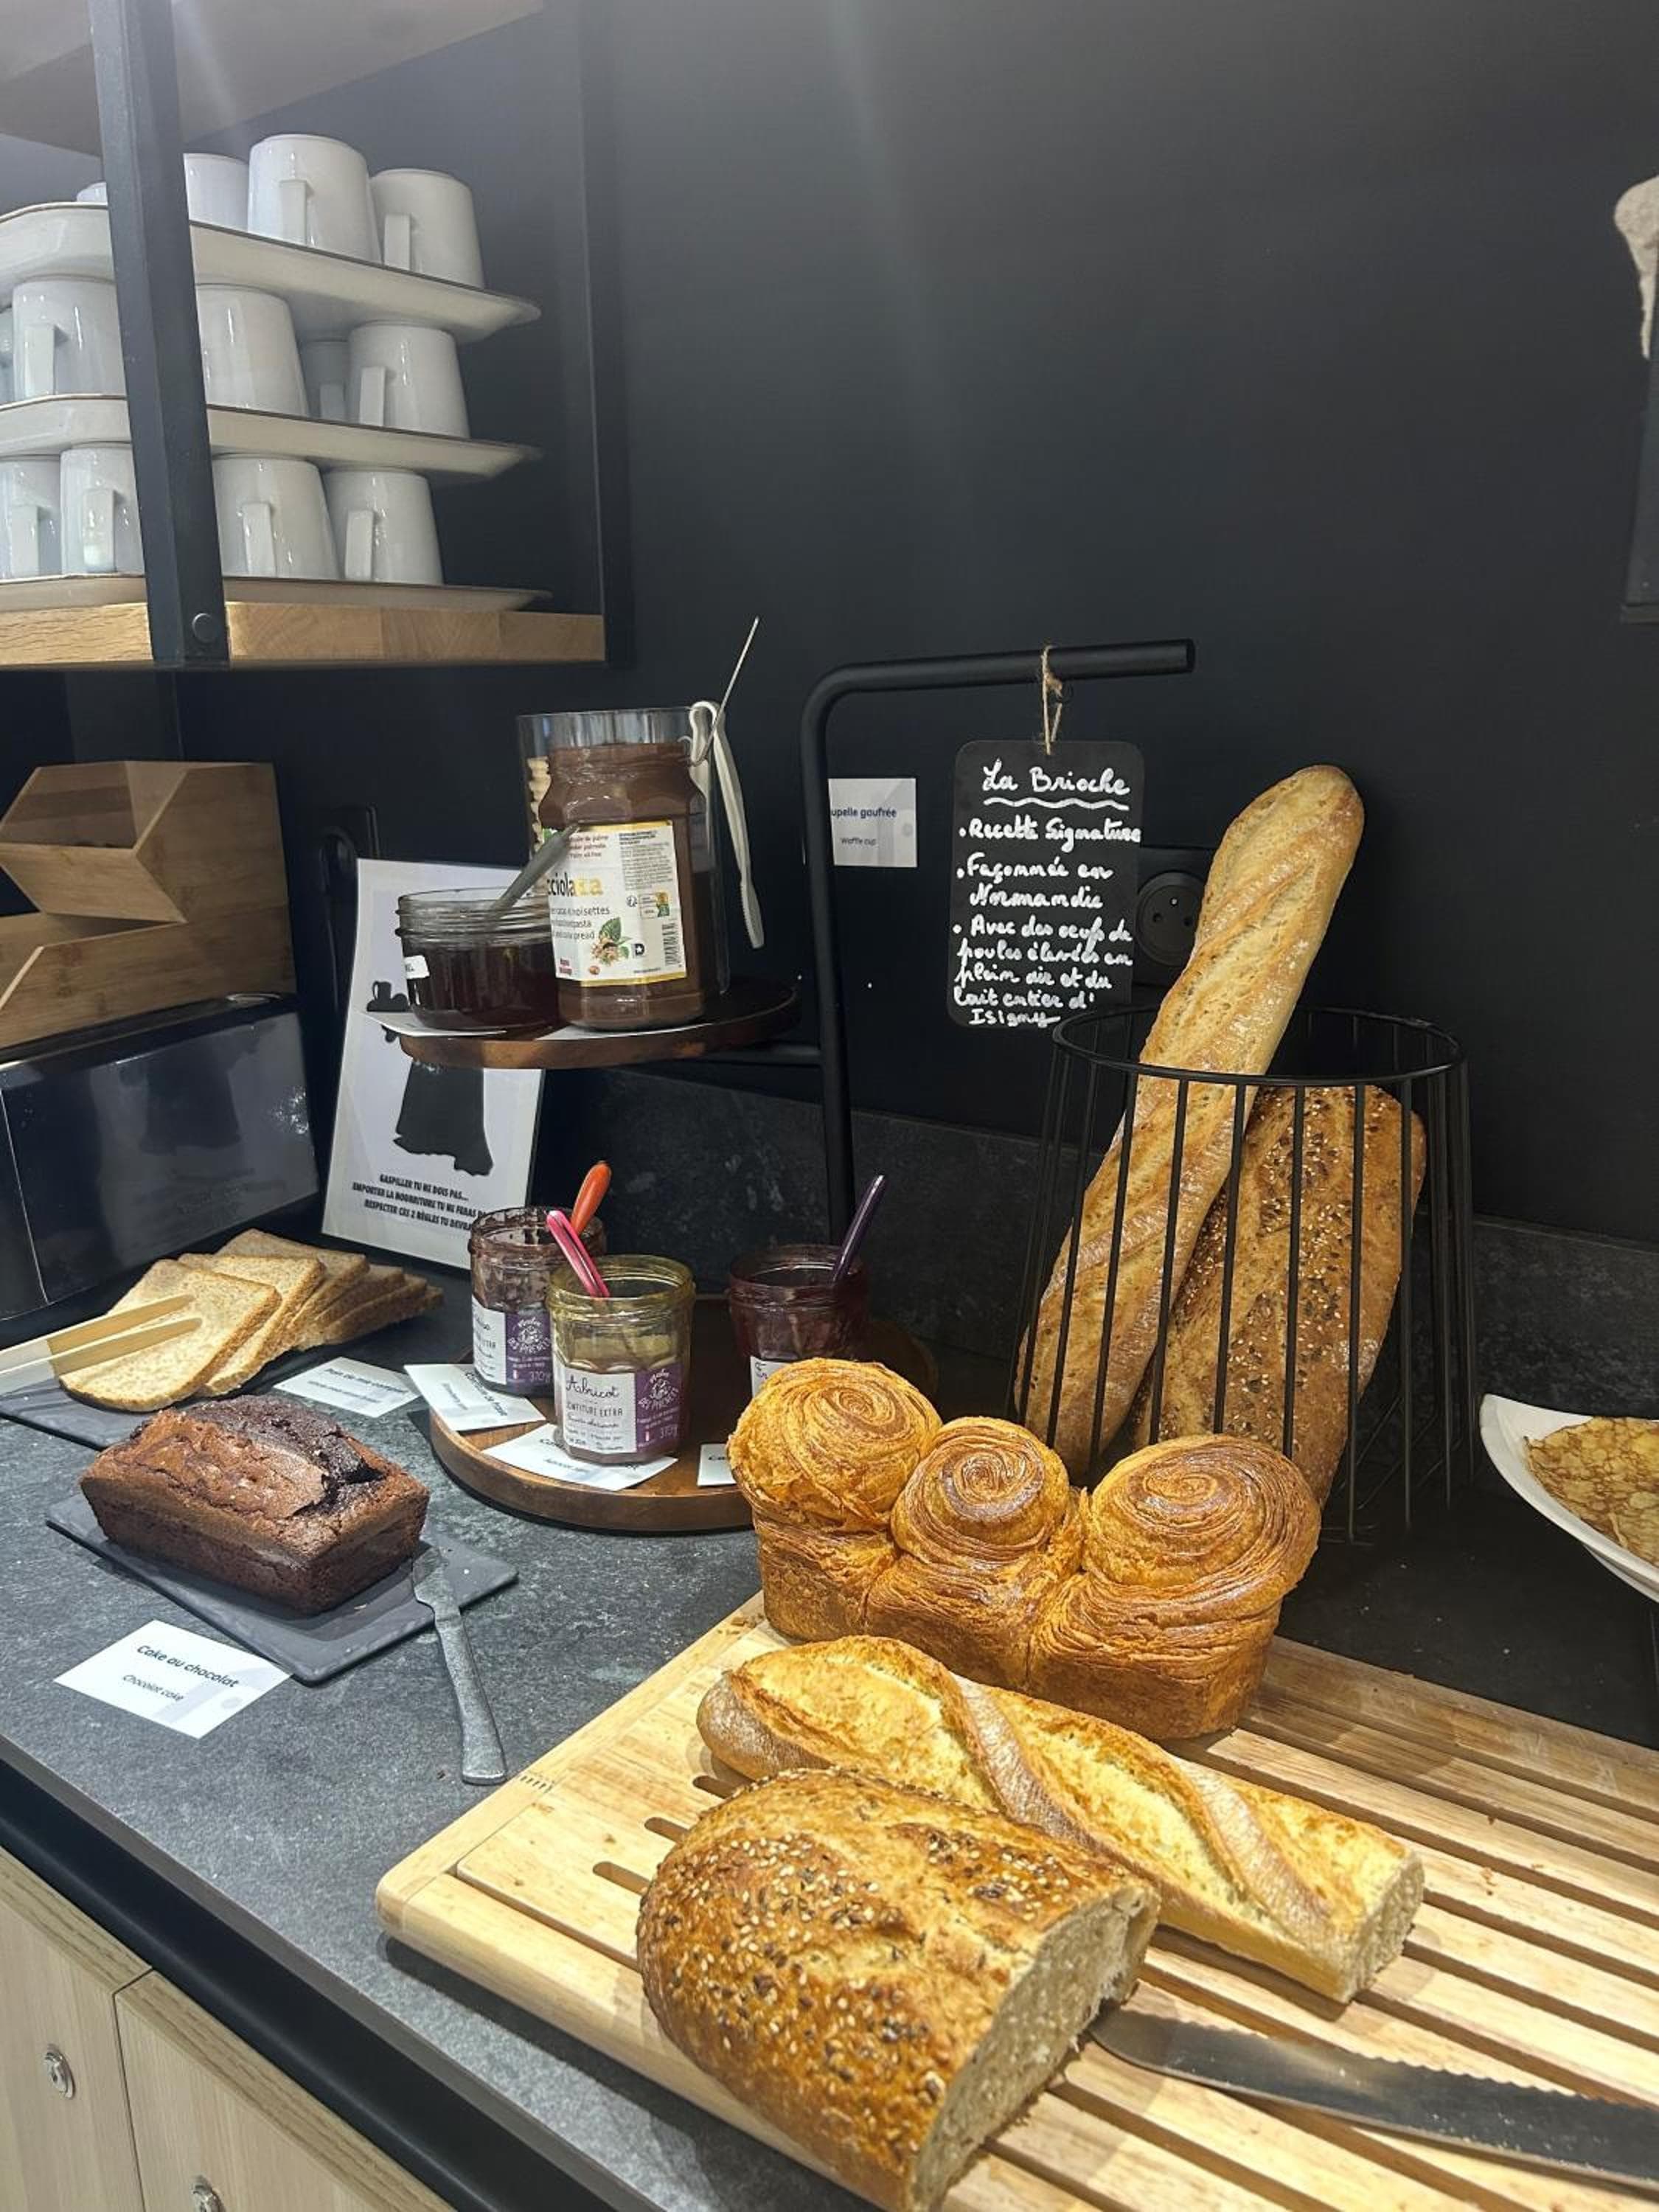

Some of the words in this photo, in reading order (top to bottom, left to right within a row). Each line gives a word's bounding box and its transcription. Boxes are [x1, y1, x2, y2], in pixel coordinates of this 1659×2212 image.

[982, 758, 1019, 791] La
[1029, 766, 1131, 796] Brioche
[831, 807, 858, 818] upelle
[1045, 816, 1141, 853] Signature
[967, 852, 1070, 884] Façonnée
[1077, 863, 1114, 880] en
[969, 883, 1104, 909] Normandie
[970, 914, 1016, 937] Avec
[1020, 914, 1054, 937] des
[1108, 917, 1133, 942] de
[956, 937, 1023, 967] poules
[1104, 952, 1133, 965] en
[954, 961, 1021, 989] plein
[1026, 965, 1055, 986] air
[1060, 966, 1084, 987] et
[1085, 970, 1113, 988] du
[953, 986, 999, 1006] lait
[1002, 989, 1064, 1009] entier
[1068, 990, 1096, 1009] d'
[968, 1008, 1061, 1028] Isigny
[352, 1182, 386, 1197] EMPORTER
[386, 1189, 394, 1200] LA
[394, 1191, 437, 1209] NOURRITURE
[437, 1201, 446, 1211] TU
[446, 1203, 455, 1213] NE
[380, 1174, 413, 1189] GASPILLER
[414, 1181, 422, 1191] TU
[422, 1183, 432, 1193] NE
[433, 1186, 449, 1197] DOIS
[364, 1199, 398, 1214] RESPECTER
[411, 1208, 416, 1219] 2
[440, 1215, 450, 1227] TU
[566, 1374, 620, 1399] Abricot
[136, 1644, 167, 1662] Cake
[167, 1656, 185, 1668] au
[184, 1662, 240, 1688] chocolat
